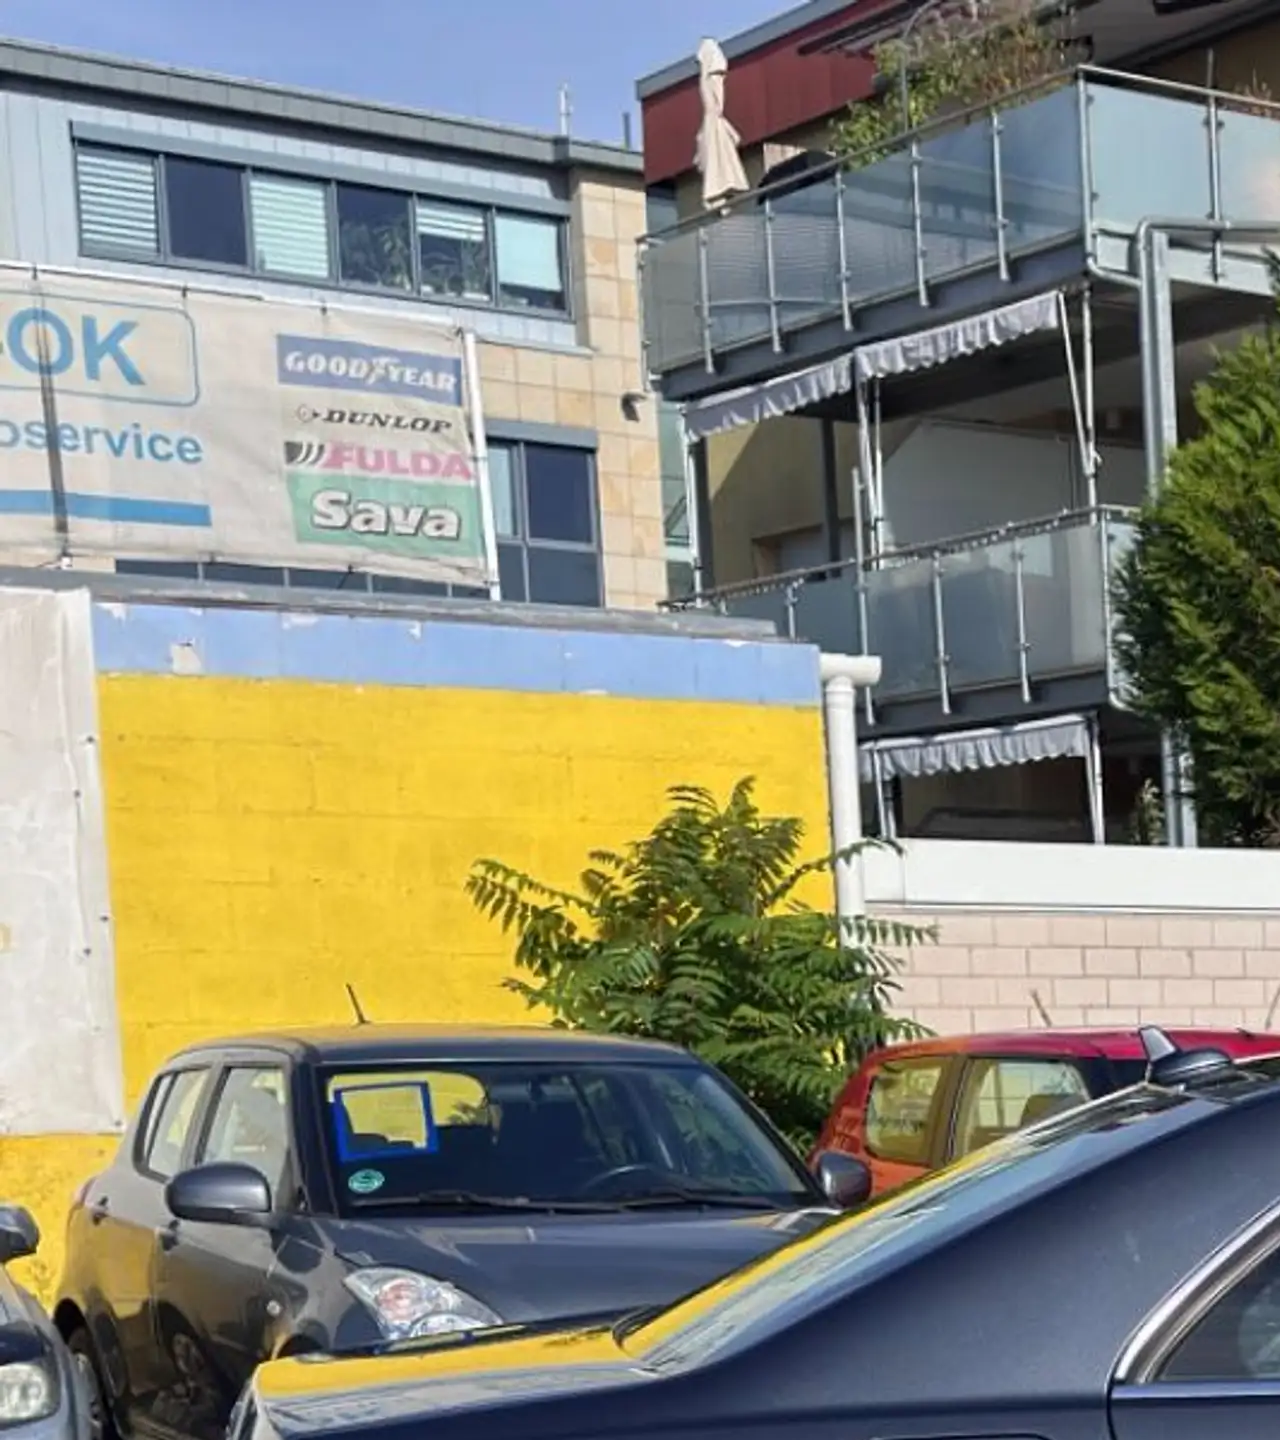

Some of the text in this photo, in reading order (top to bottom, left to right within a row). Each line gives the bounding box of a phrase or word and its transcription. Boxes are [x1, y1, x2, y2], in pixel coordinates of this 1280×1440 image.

[284, 351, 457, 392] GOODYEAR
[322, 409, 452, 435] DUNLOP
[320, 442, 472, 480] FULDA
[311, 487, 462, 541] Sava
